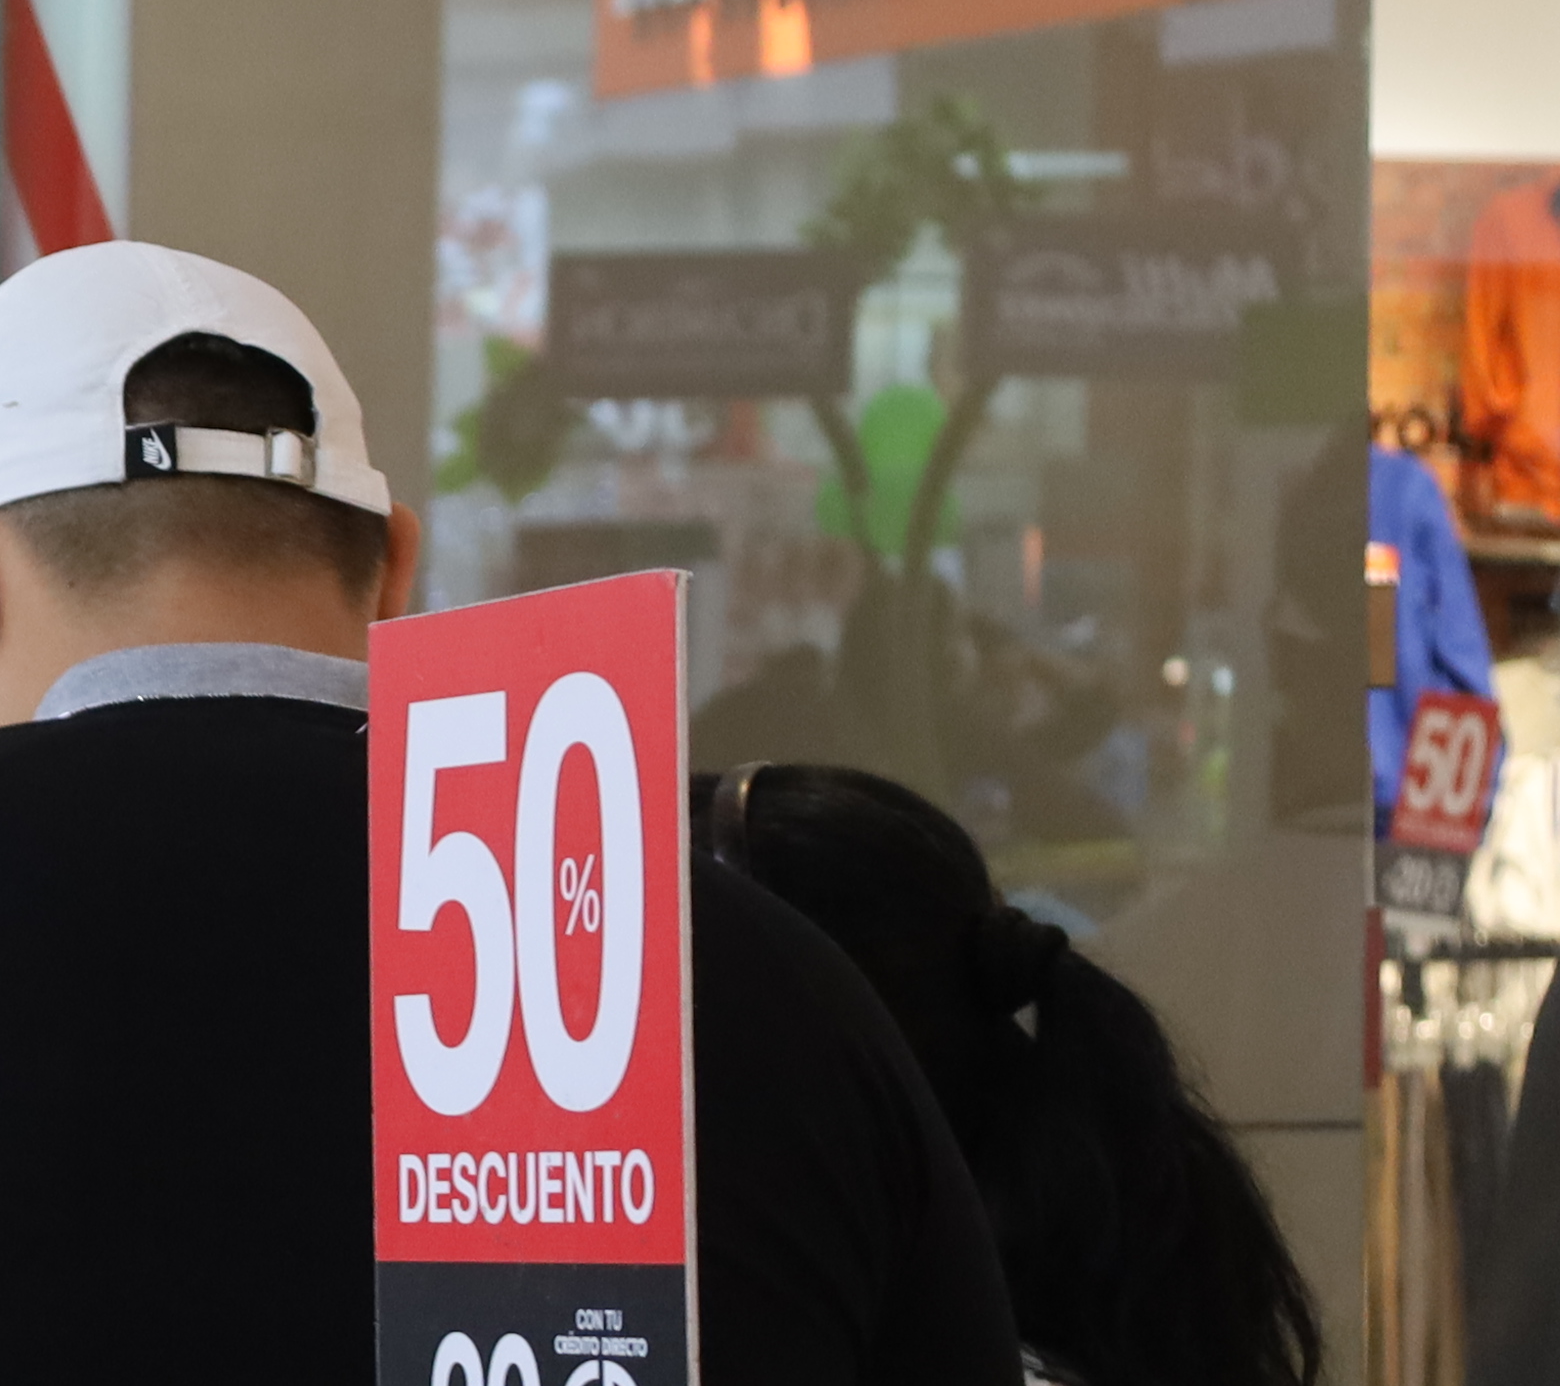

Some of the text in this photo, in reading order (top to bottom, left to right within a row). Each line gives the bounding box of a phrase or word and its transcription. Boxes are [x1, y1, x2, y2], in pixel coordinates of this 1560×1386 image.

[397, 1148, 655, 1225] DESCUENTO
[575, 1308, 623, 1332] CON TU
[553, 1330, 649, 1358] CRÉDITO DIRECTO
